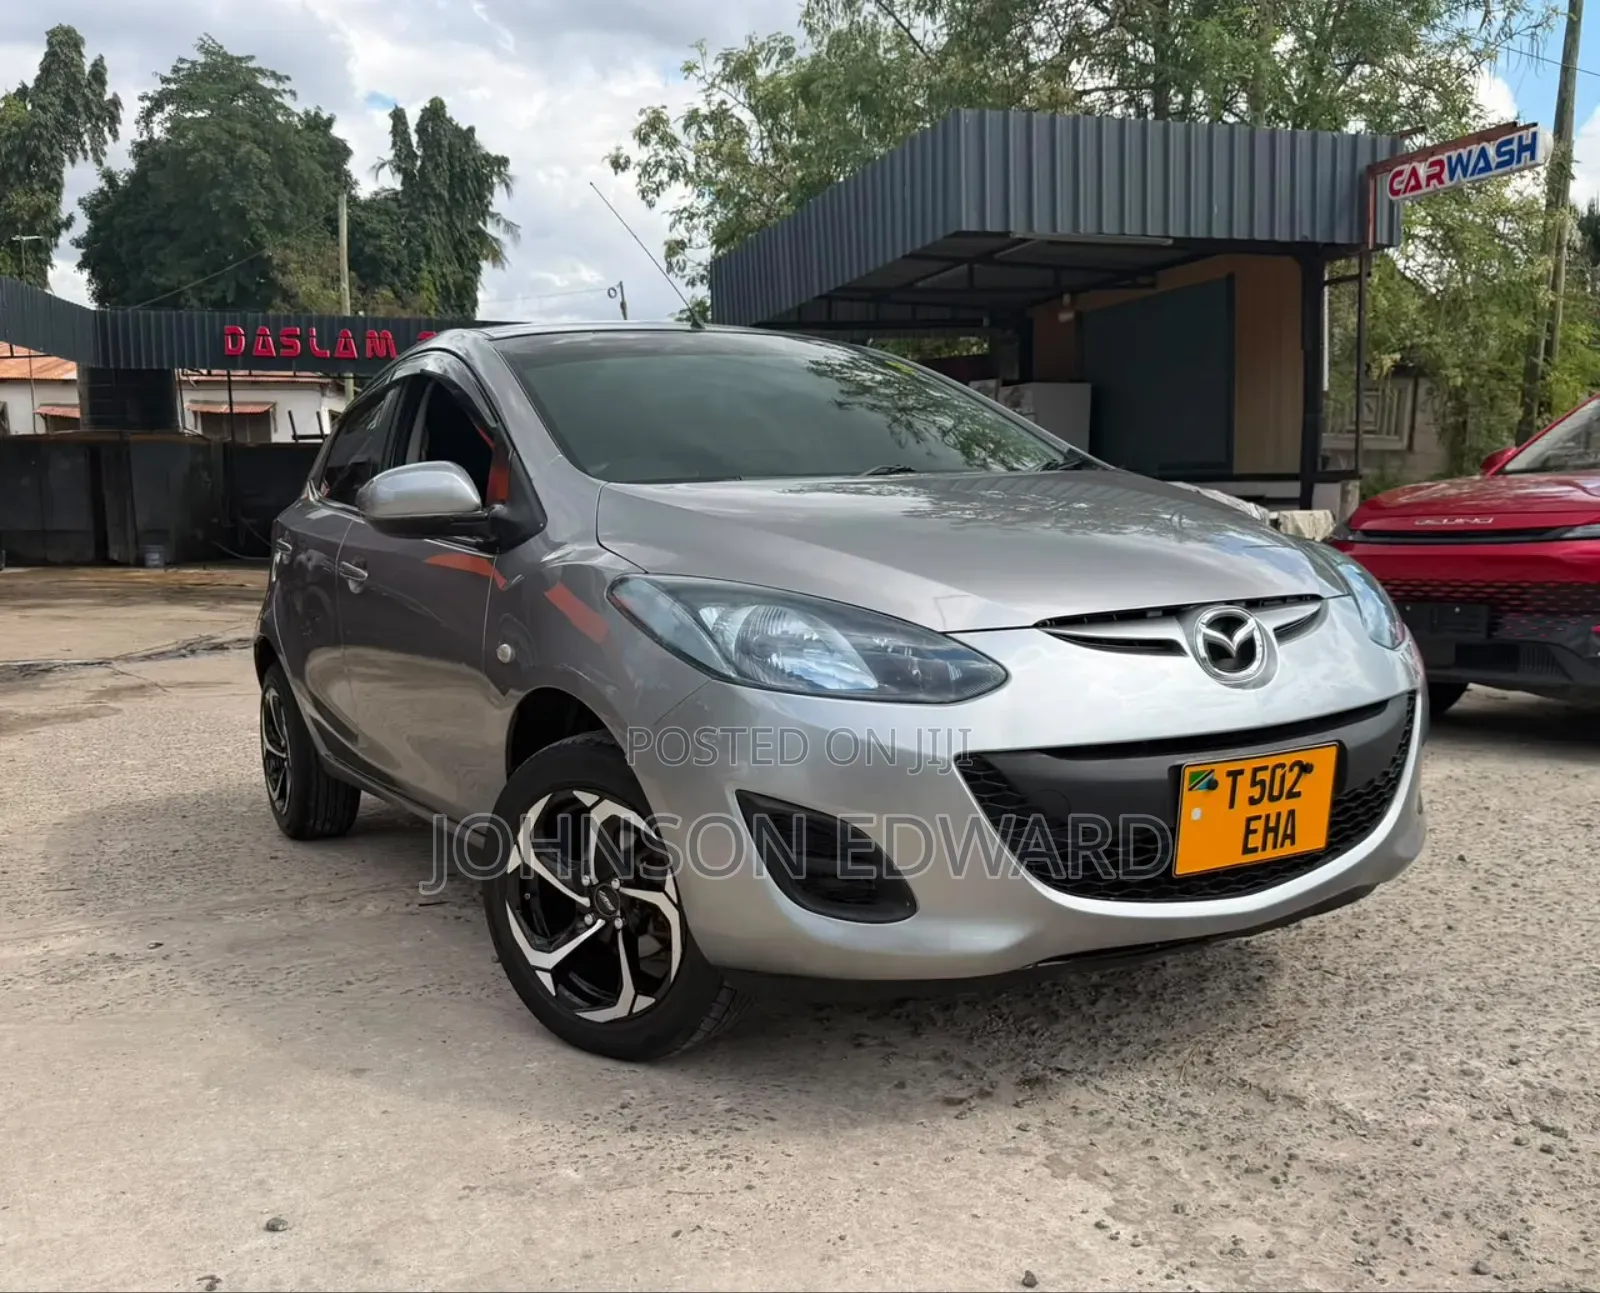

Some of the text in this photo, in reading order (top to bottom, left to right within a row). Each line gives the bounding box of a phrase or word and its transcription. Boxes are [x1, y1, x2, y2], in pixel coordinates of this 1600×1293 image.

[1388, 131, 1539, 197] CARWASH
[223, 325, 399, 360] DASLAM
[1241, 808, 1297, 856] EHA
